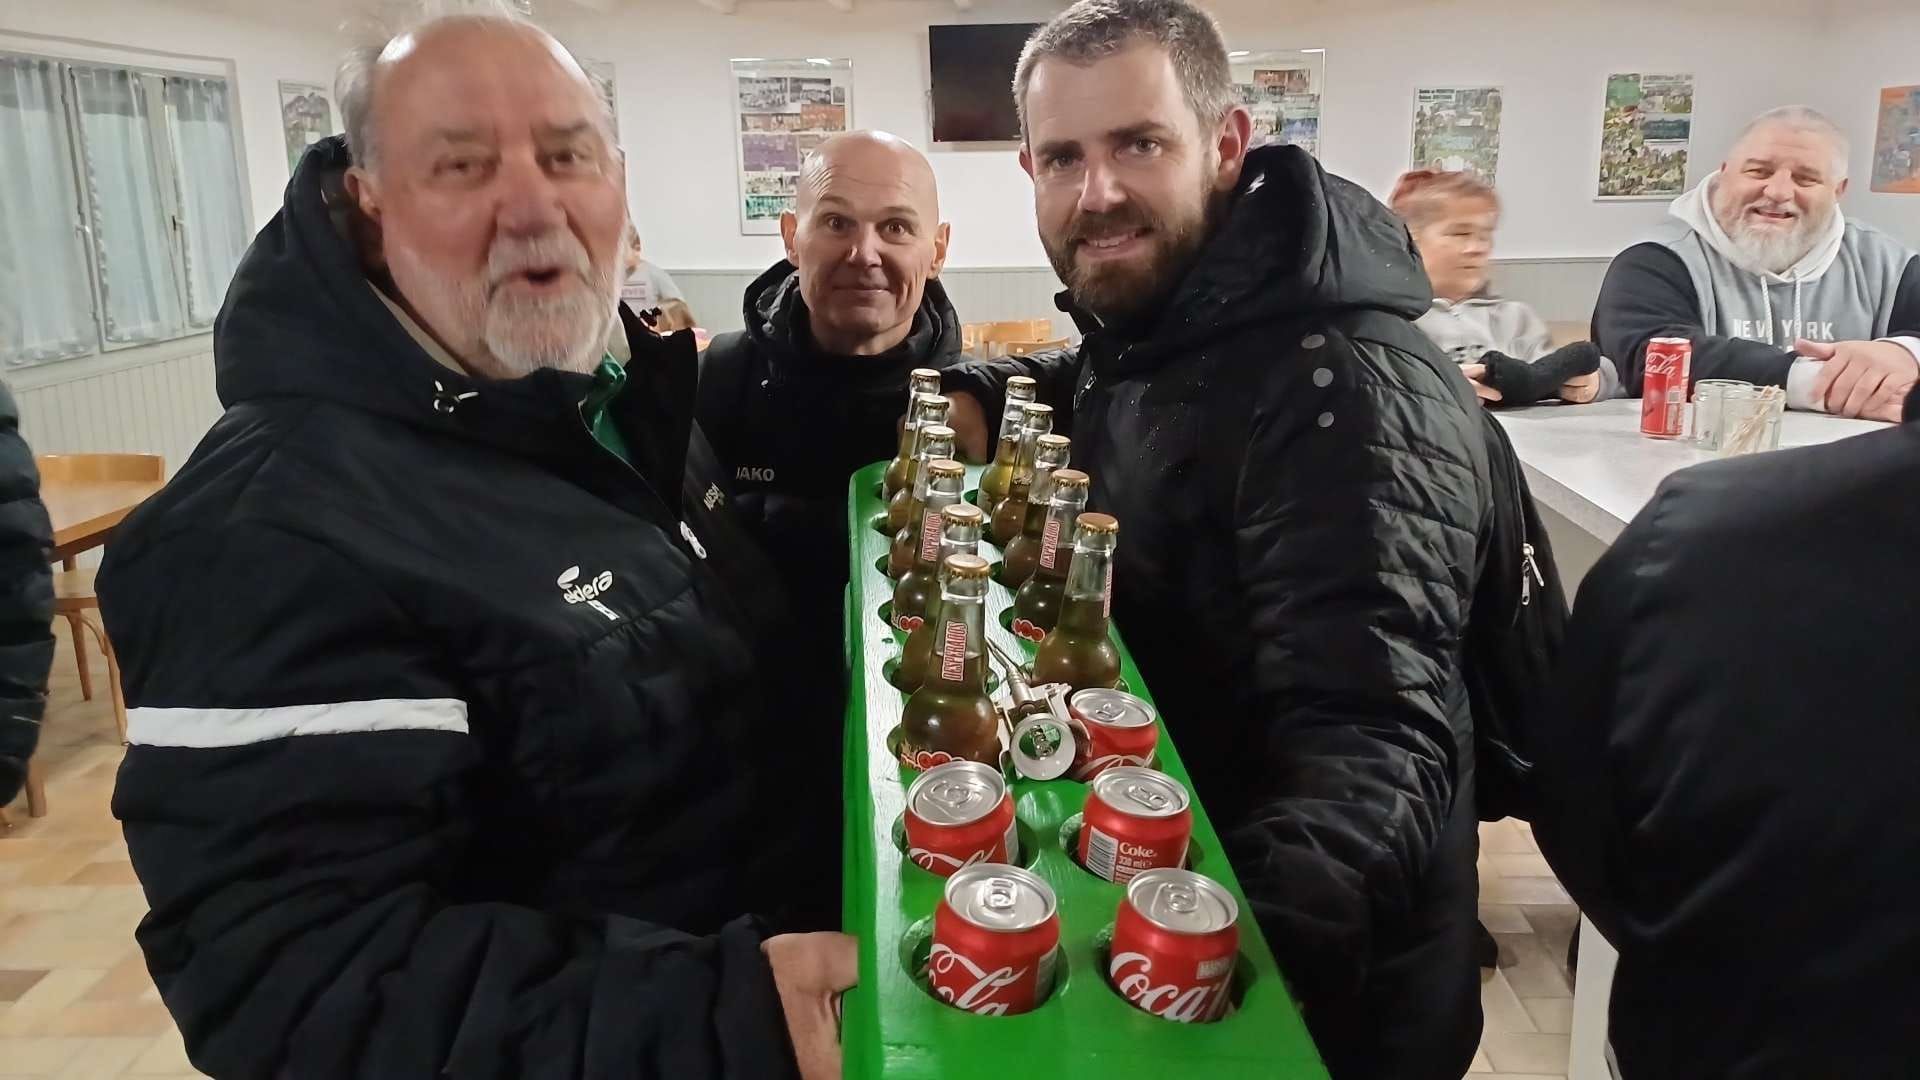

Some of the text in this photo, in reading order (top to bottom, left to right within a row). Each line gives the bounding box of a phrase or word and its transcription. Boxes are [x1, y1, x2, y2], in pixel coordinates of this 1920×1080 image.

[1782, 319, 1834, 340] YRK
[736, 466, 775, 482] JAKO
[1040, 520, 1061, 570] DESPERADOS
[942, 620, 967, 681] DESPERADOS
